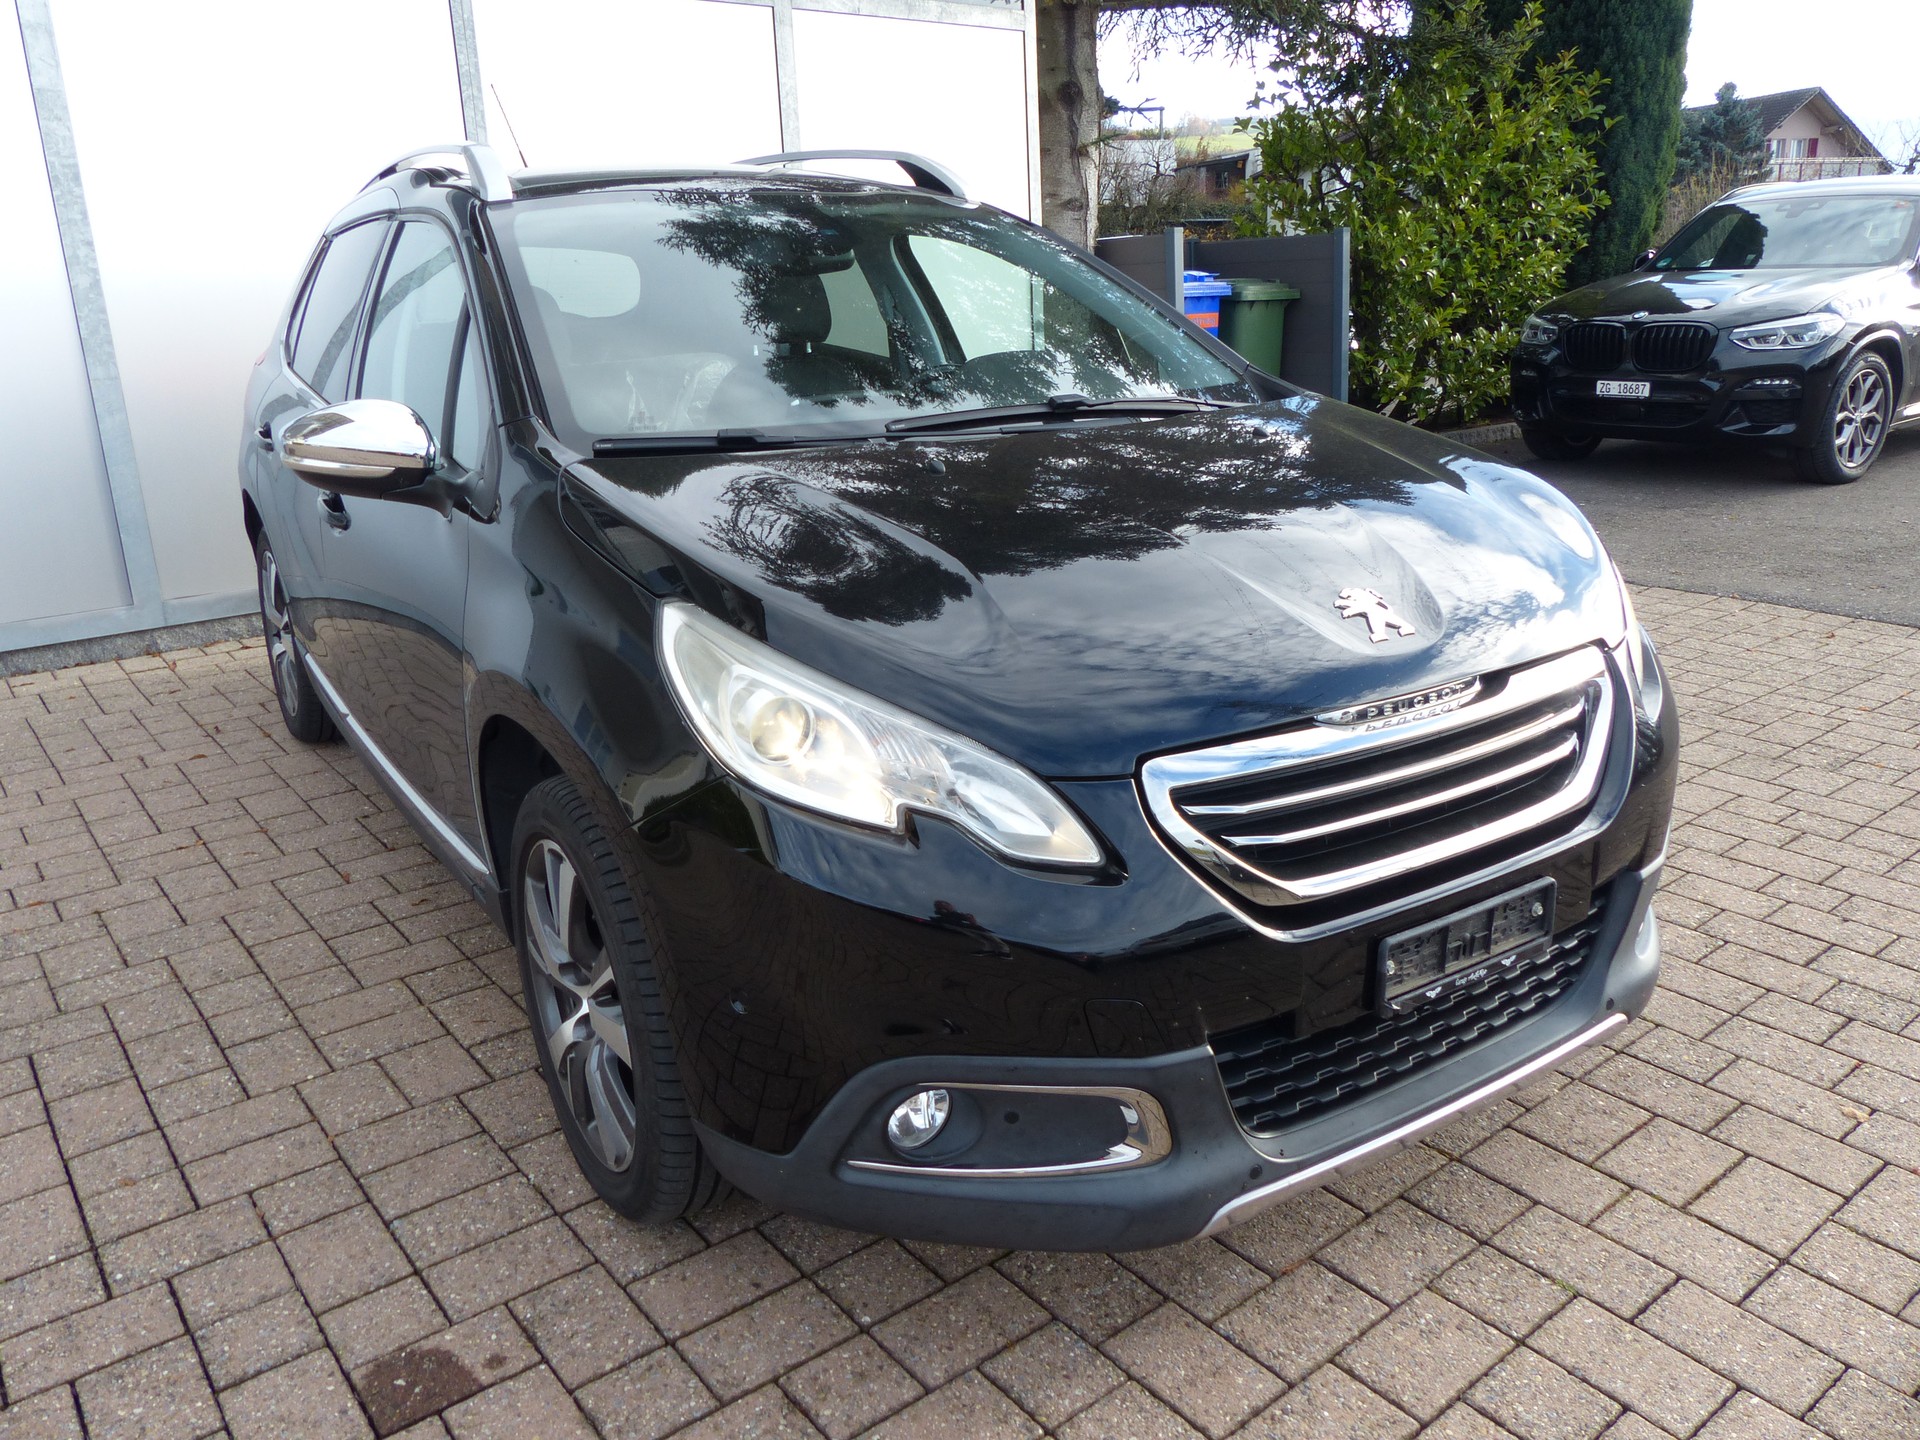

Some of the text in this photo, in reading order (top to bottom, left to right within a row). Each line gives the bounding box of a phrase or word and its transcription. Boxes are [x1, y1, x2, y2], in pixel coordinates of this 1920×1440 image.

[1599, 382, 1647, 395] ZG 18687
[1366, 683, 1465, 720] PEUGEOT
